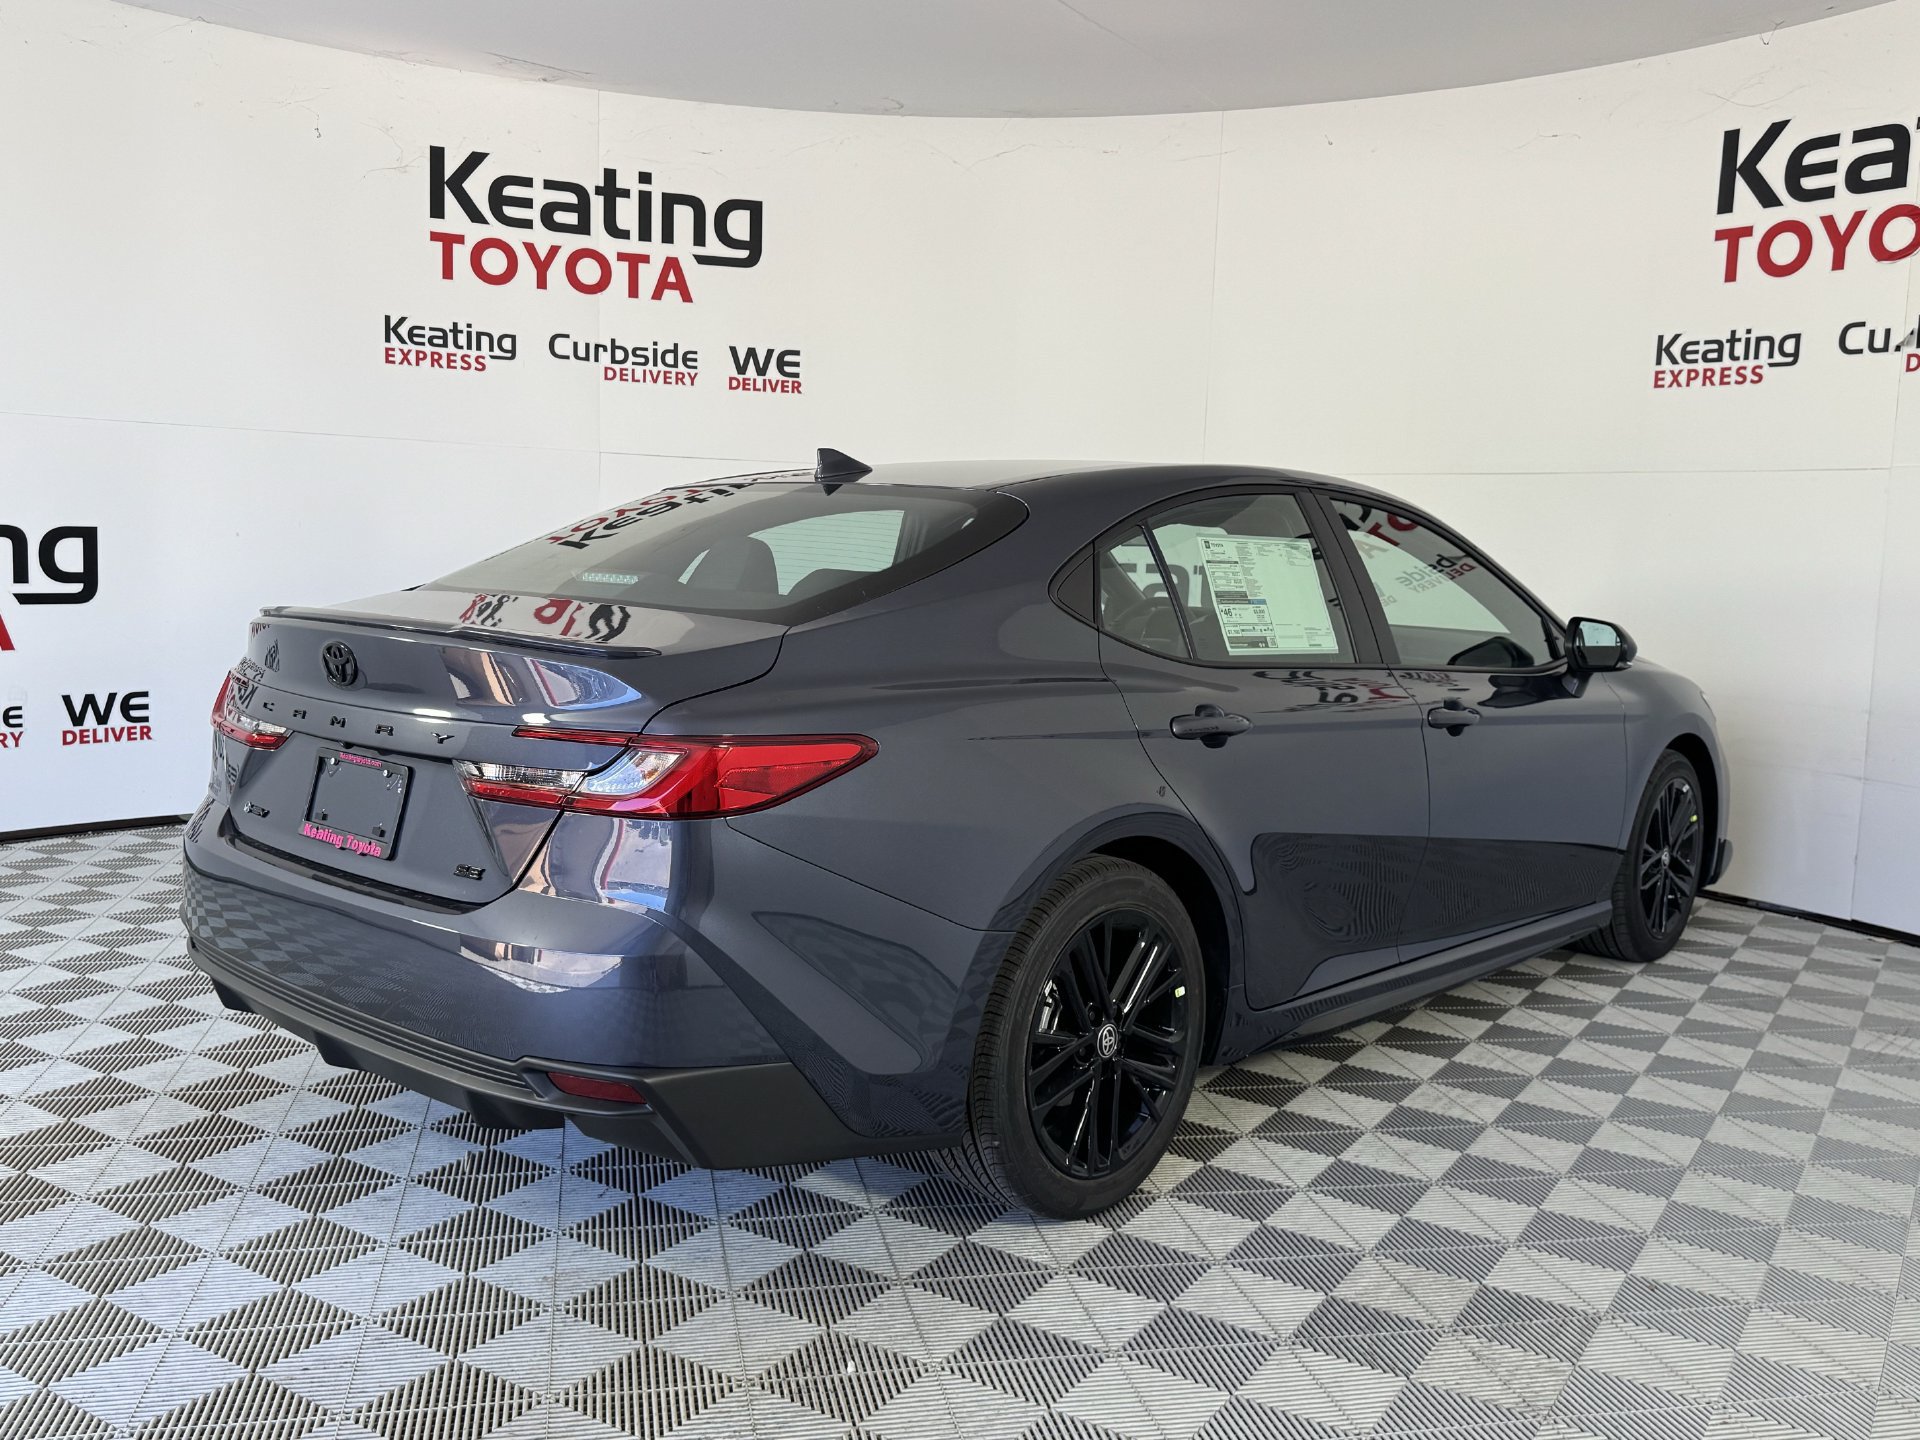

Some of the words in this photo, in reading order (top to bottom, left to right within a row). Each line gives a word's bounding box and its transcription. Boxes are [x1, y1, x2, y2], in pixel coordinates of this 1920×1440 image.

[1716, 116, 1920, 215] Kea
[429, 144, 763, 269] Keating
[429, 230, 693, 304] TOYOTA
[384, 314, 517, 361] Keating
[548, 333, 698, 370] Curbside
[728, 345, 801, 379] WE
[1655, 328, 1802, 368] Keating
[384, 347, 487, 372] EXPRESS
[603, 366, 698, 387] DELIVERY
[728, 376, 802, 394] DELIVER
[1653, 365, 1764, 388] EXPRESS
[61, 690, 150, 727] WE
[263, 701, 455, 744] CAMRY
[62, 725, 152, 747] DELIVER
[303, 823, 344, 849] Keating
[346, 834, 382, 857] Toyota
